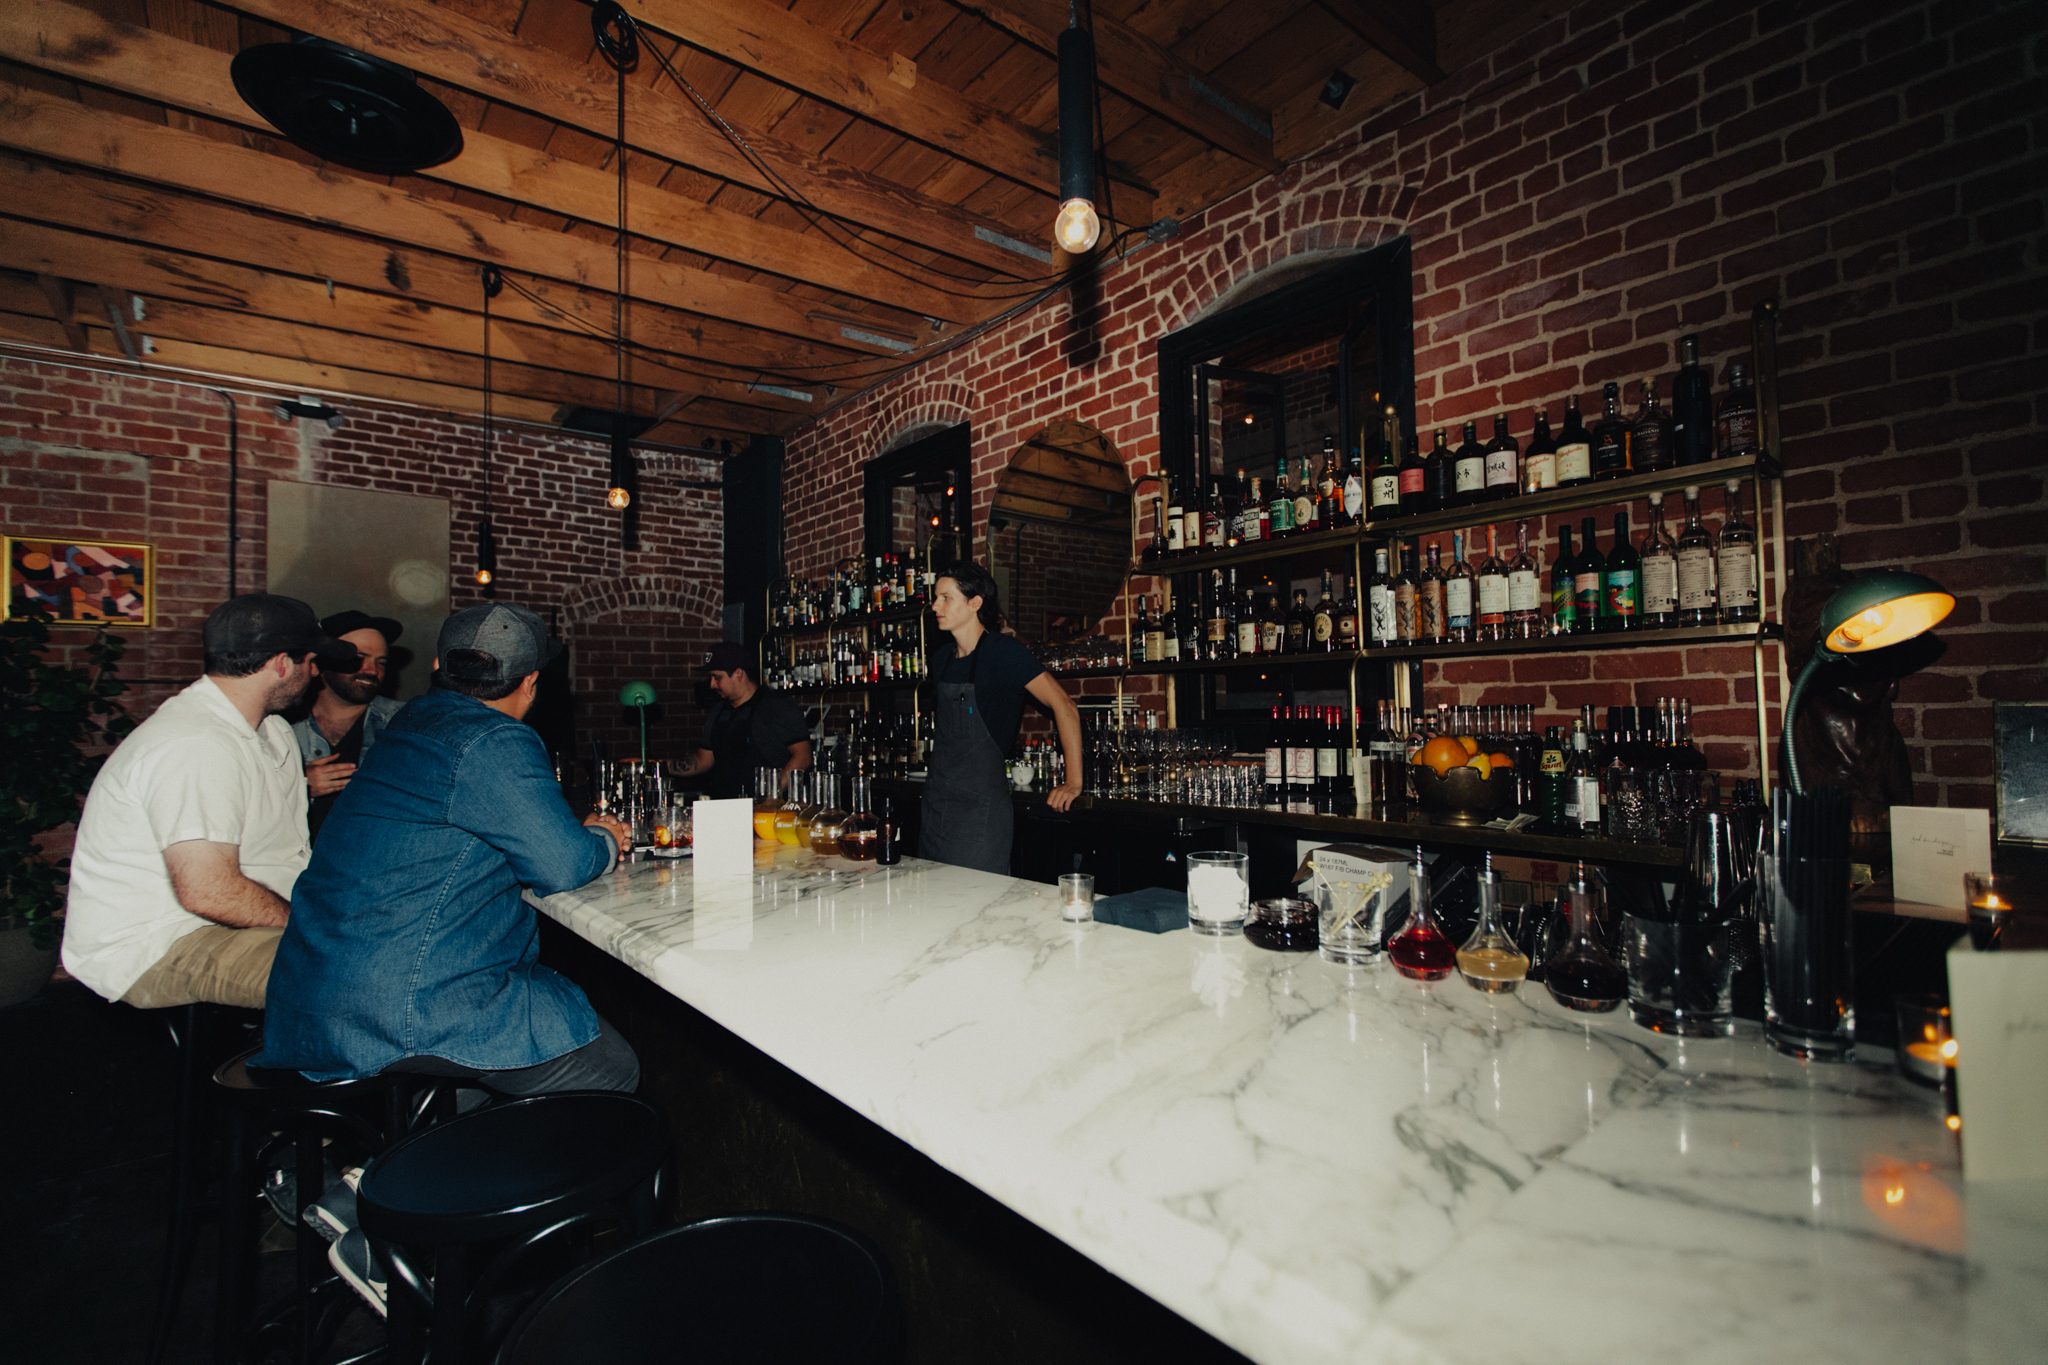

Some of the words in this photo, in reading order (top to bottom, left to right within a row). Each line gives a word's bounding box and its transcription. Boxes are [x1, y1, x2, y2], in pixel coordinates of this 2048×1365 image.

[1541, 761, 1562, 770] Squirt
[1331, 859, 1349, 867] 187ML
[1345, 868, 1367, 876] CHAMP
